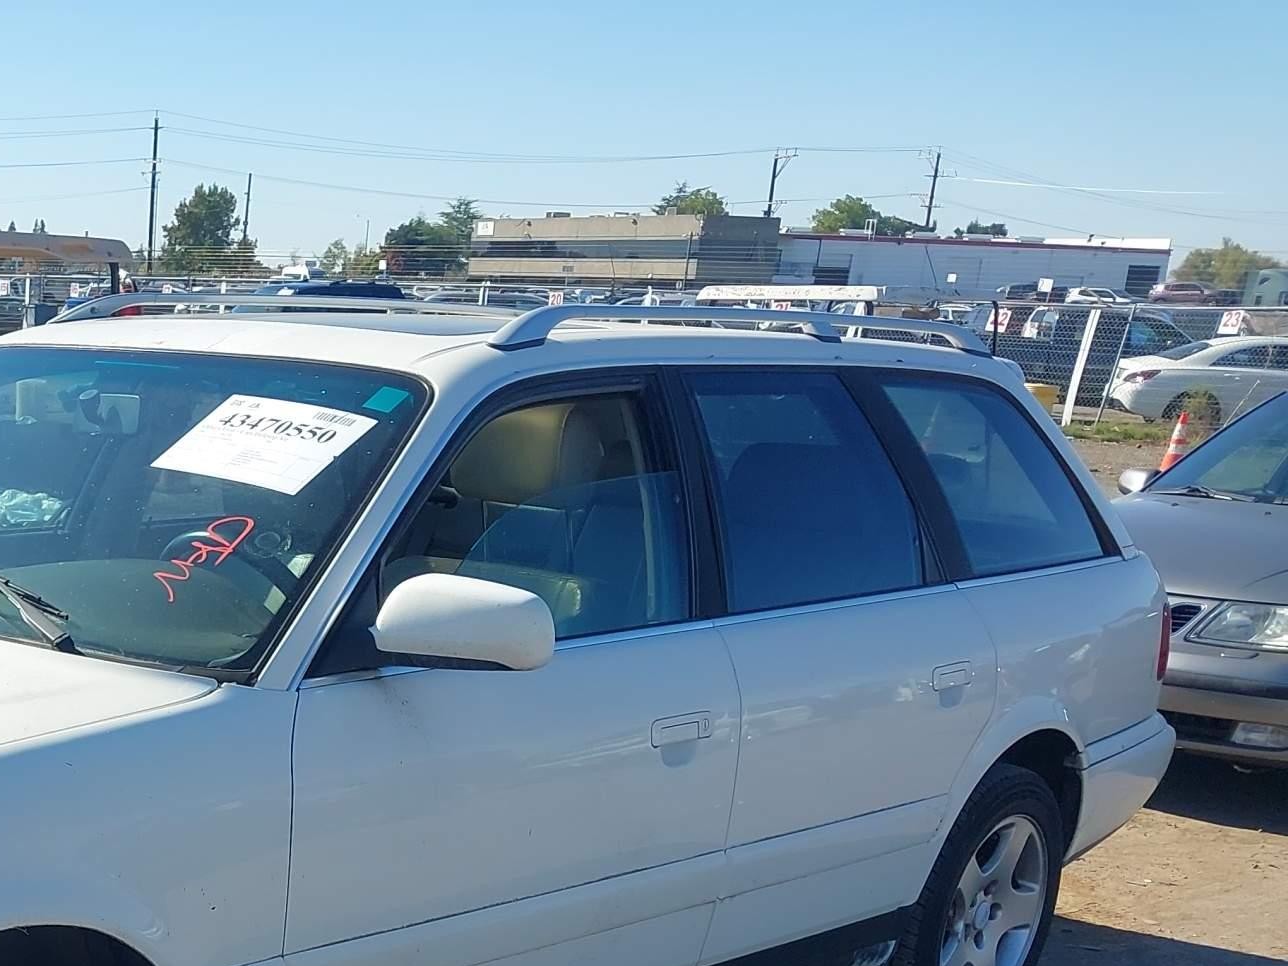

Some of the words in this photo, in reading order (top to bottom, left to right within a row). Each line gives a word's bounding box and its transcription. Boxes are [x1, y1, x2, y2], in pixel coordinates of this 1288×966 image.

[550, 293, 562, 305] 20
[1222, 311, 1242, 328] 23
[219, 412, 337, 443] 43470550
